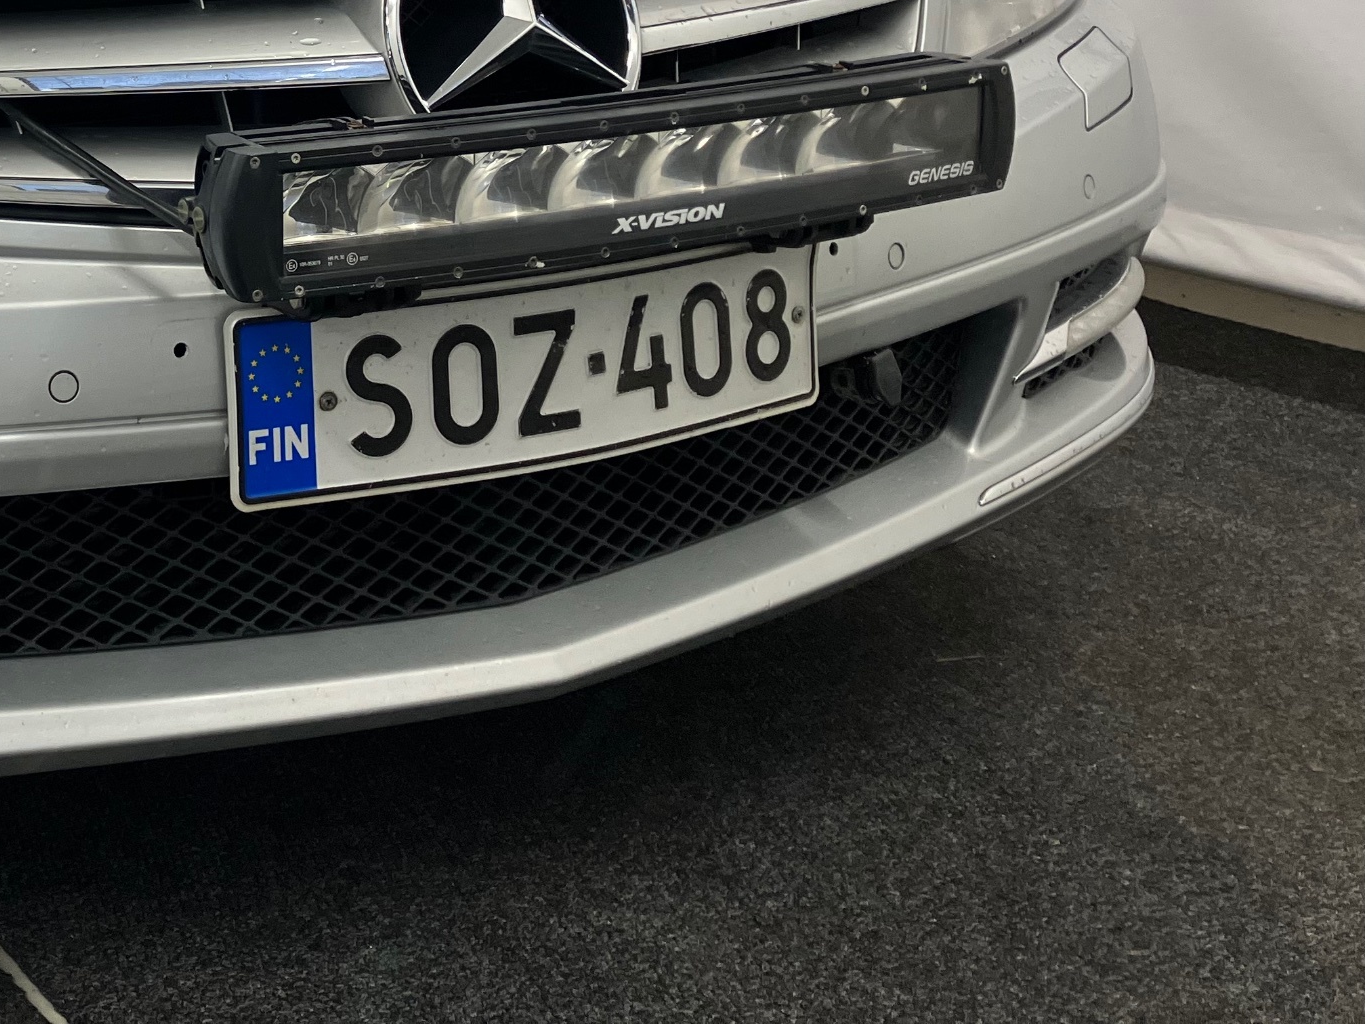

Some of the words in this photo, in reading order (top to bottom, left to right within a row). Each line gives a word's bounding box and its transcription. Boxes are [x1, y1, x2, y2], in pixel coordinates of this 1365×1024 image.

[908, 160, 974, 186] GENESIS
[612, 202, 726, 235] X-VISION
[345, 268, 792, 458] SOZ-408
[248, 423, 310, 466] FIN
